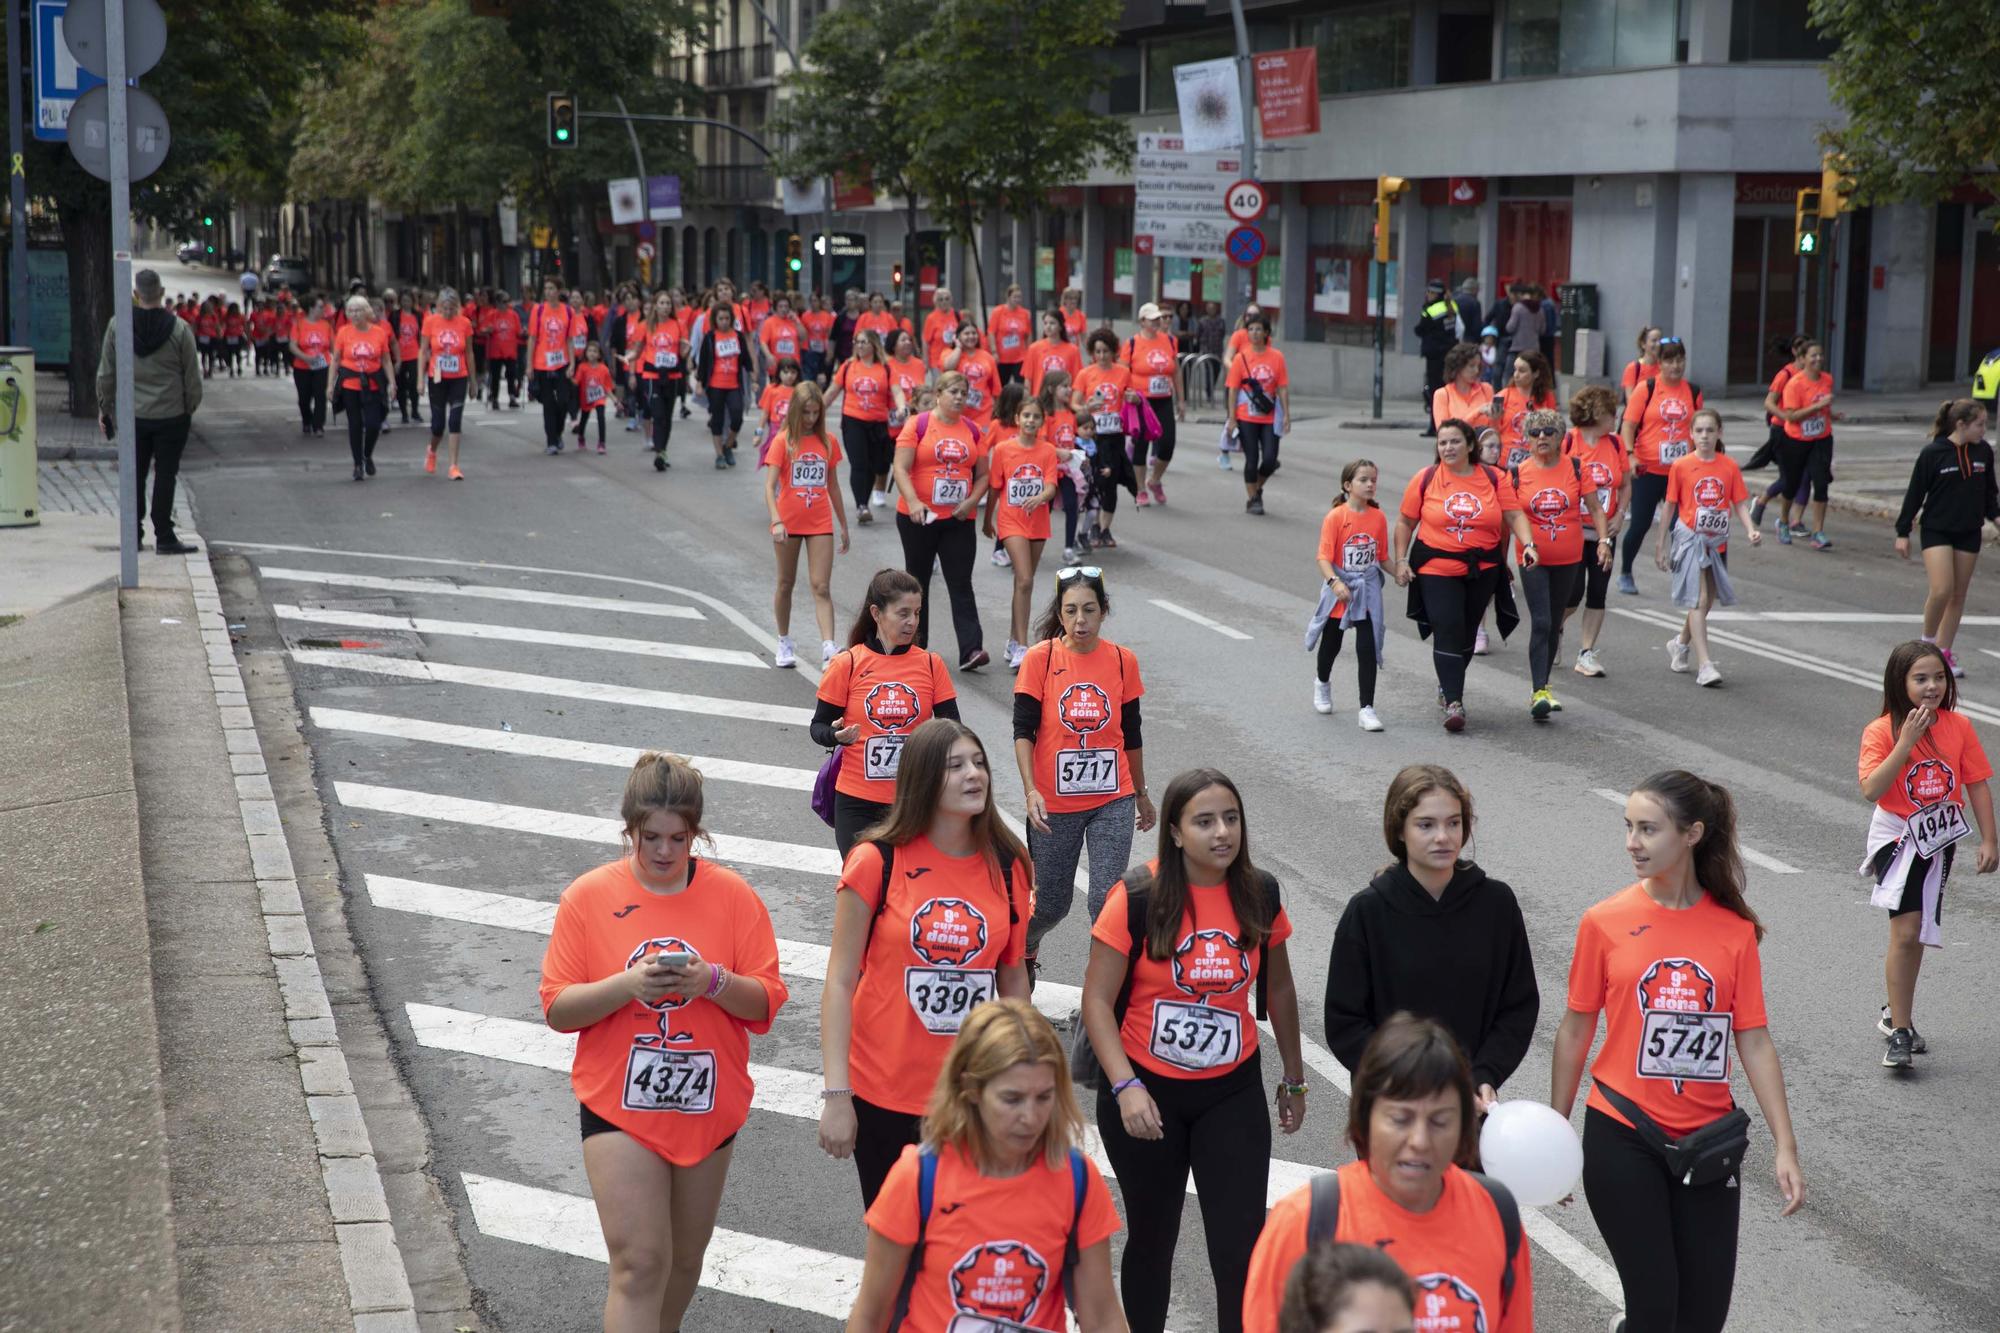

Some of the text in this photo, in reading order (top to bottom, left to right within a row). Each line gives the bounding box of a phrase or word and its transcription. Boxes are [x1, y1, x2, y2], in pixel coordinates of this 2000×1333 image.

[1743, 182, 1798, 200] Santa
[1234, 194, 1259, 208] 40
[794, 466, 824, 479] 3023
[940, 485, 962, 498] 271
[1011, 485, 1041, 498] 3022
[1699, 515, 1727, 528] 3366
[877, 705, 908, 715] dona
[1070, 707, 1100, 718] dona
[870, 746, 902, 767] 57
[1062, 760, 1114, 783] 5717
[1918, 785, 1944, 796] dona
[1918, 804, 1959, 843] 4942
[933, 921, 968, 933] cursa
[926, 929, 970, 946] dona
[931, 944, 961, 953] GIRONA
[1194, 957, 1230, 966] cursa
[1190, 967, 1234, 979] dona
[1659, 986, 1697, 997] cursa
[1653, 995, 1700, 1011] dona
[1160, 1018, 1232, 1056] 5371
[1648, 1028, 1723, 1061] 5742
[633, 1065, 710, 1096] 4374
[977, 1277, 1024, 1287] cursa
[970, 1286, 1026, 1304] dona
